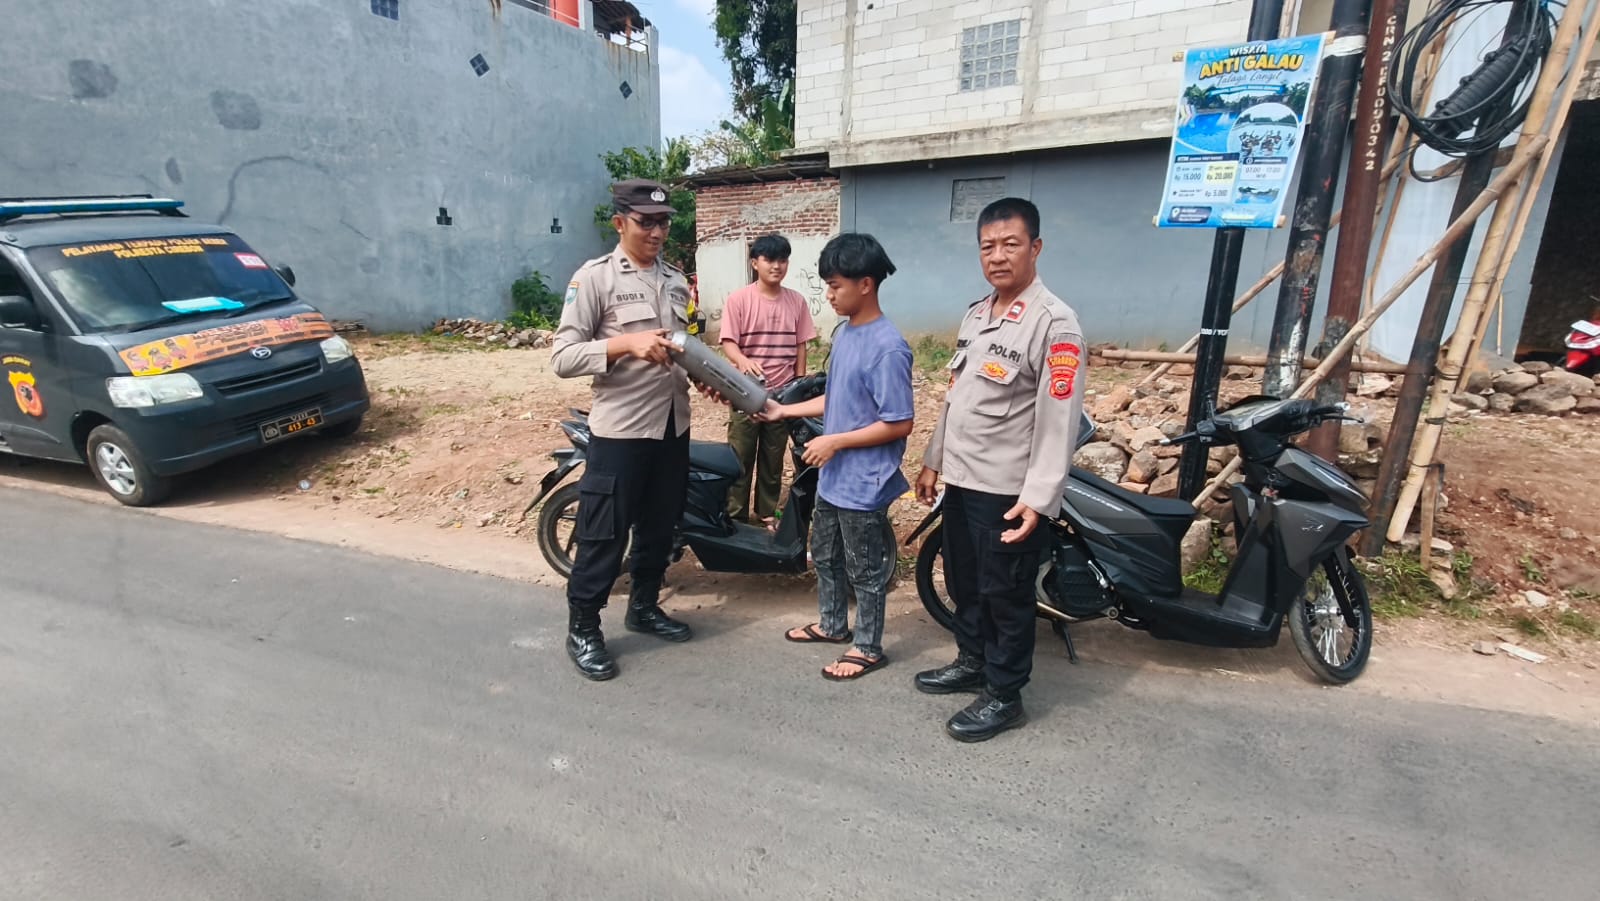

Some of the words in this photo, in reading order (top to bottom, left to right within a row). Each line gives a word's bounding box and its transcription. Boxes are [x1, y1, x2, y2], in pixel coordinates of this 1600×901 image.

[1229, 44, 1268, 56] WISATA
[1200, 58, 1239, 80] ANTI
[1243, 54, 1304, 71] GALAU
[988, 343, 1022, 363] POLRI
